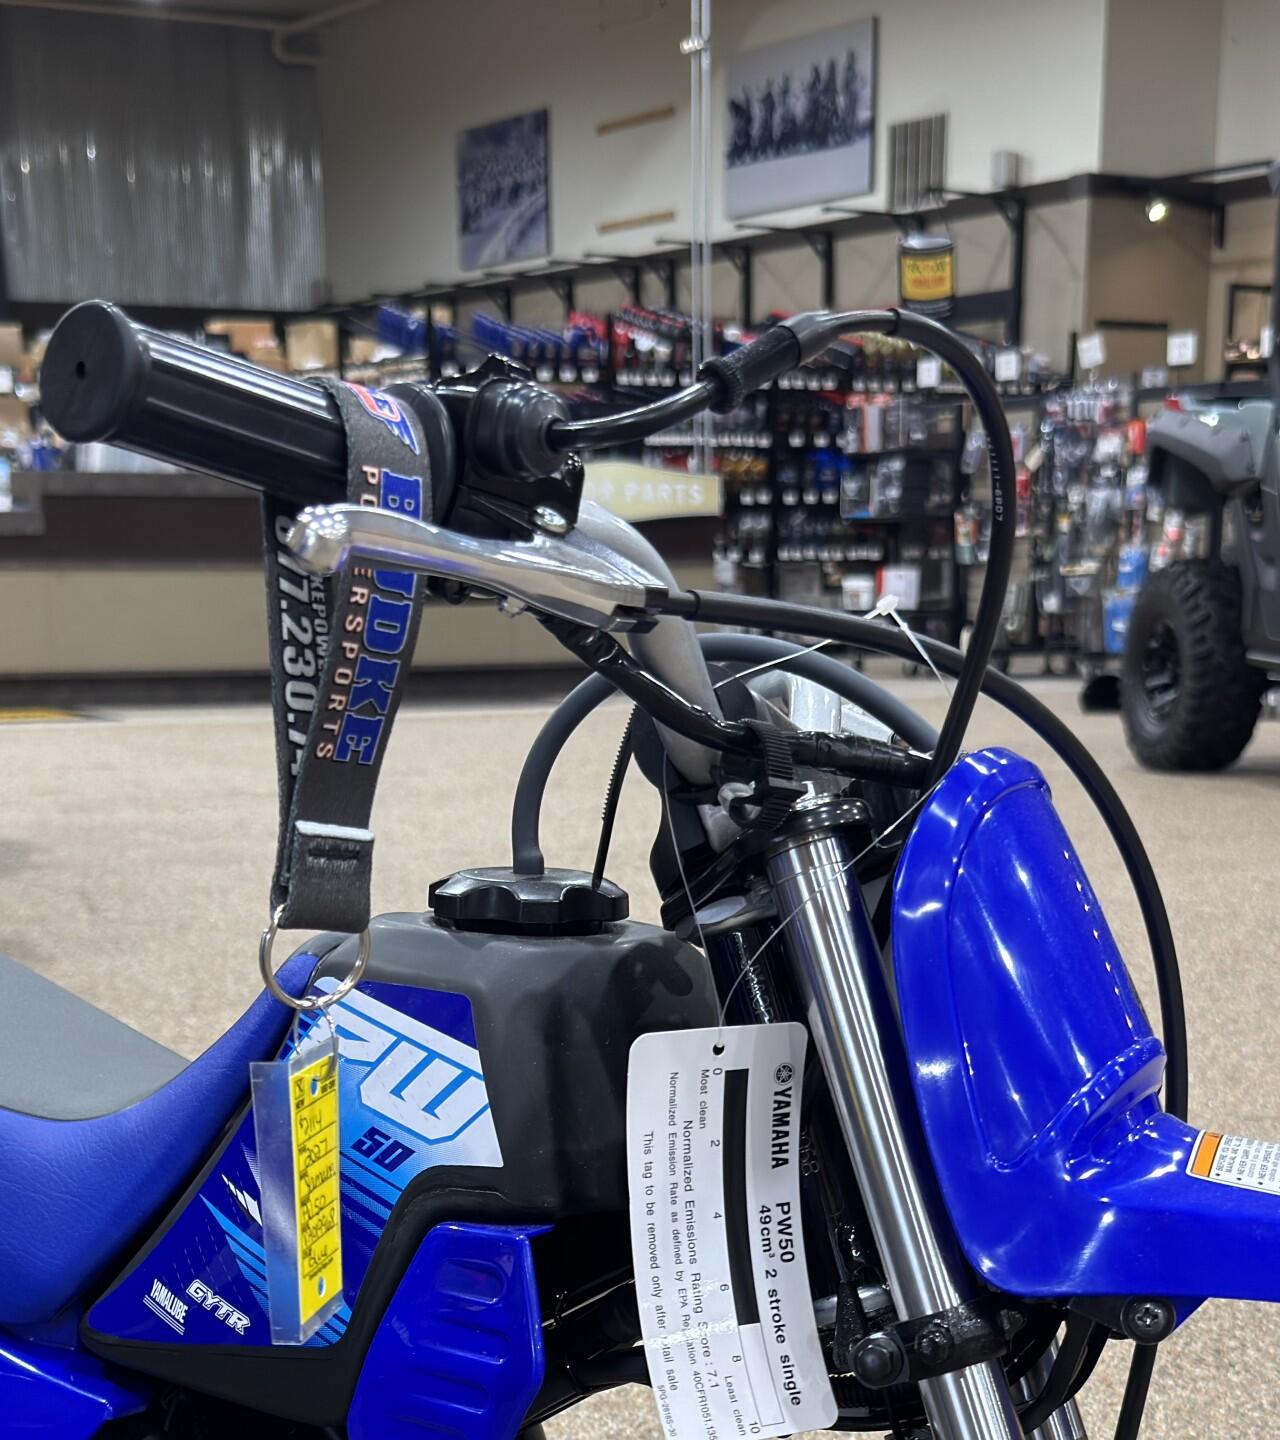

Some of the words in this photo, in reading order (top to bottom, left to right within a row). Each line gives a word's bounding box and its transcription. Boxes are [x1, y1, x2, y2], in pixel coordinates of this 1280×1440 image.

[623, 480, 704, 505] PARTS
[700, 1069, 710, 1095] Most
[712, 1067, 723, 1076] 0
[669, 1071, 679, 1126] Normalized
[699, 1100, 709, 1129] clean
[771, 1086, 792, 1169] YAMAHA
[350, 1126, 416, 1172] 50
[643, 1131, 654, 1155] This
[669, 1132, 679, 1176] Emission
[710, 1139, 720, 1148] 2
[683, 1120, 694, 1192] Normalized
[642, 1161, 653, 1179] tag
[645, 1185, 655, 1196] to
[669, 1182, 679, 1206] Rate
[646, 1202, 656, 1216] be
[671, 1212, 678, 1223] as
[712, 1211, 722, 1219] 4
[684, 1200, 698, 1265] Emissions
[775, 1201, 796, 1264] PW50
[647, 1222, 660, 1269] removed
[672, 1228, 683, 1265] defined
[650, 1275, 663, 1298] only
[674, 1270, 684, 1282] by
[765, 1269, 777, 1279] 2
[678, 1288, 689, 1309] EPA
[691, 1272, 703, 1314] Rating
[720, 1283, 730, 1292] 6
[150, 1278, 189, 1323] YAMALUBE
[186, 1279, 251, 1335] GYTR
[655, 1305, 668, 1330] after
[768, 1288, 786, 1344] stroke
[666, 1369, 679, 1391] sale
[707, 1369, 720, 1388] 7.1
[725, 1375, 738, 1403] Least
[780, 1354, 801, 1406] single
[733, 1409, 746, 1436] clean
[749, 1421, 760, 1434] 10
